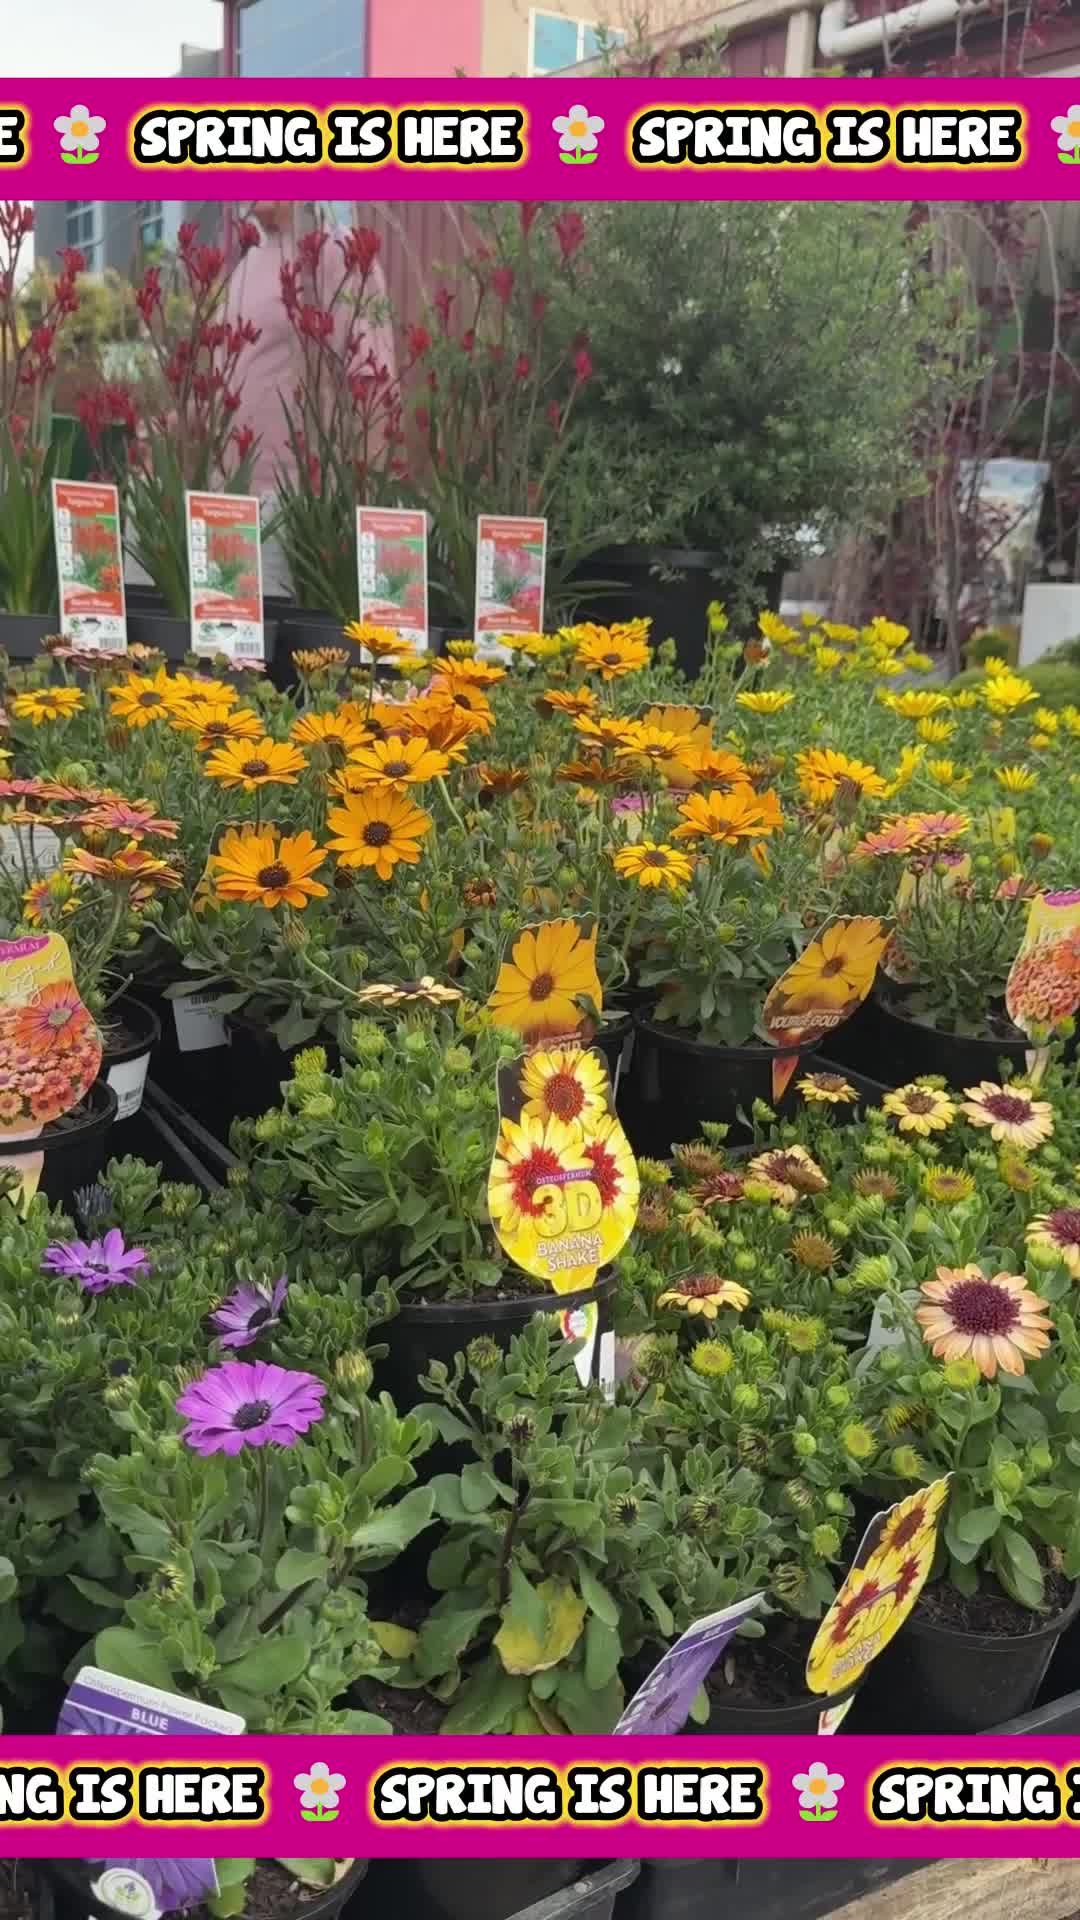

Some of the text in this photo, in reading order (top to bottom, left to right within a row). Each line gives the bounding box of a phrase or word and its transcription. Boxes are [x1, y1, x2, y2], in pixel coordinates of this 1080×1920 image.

[531, 1180, 603, 1238] 3D
[537, 1233, 603, 1257] BANANA
[547, 1248, 598, 1272] SHAKE
[130, 1707, 169, 1731] BLUE
